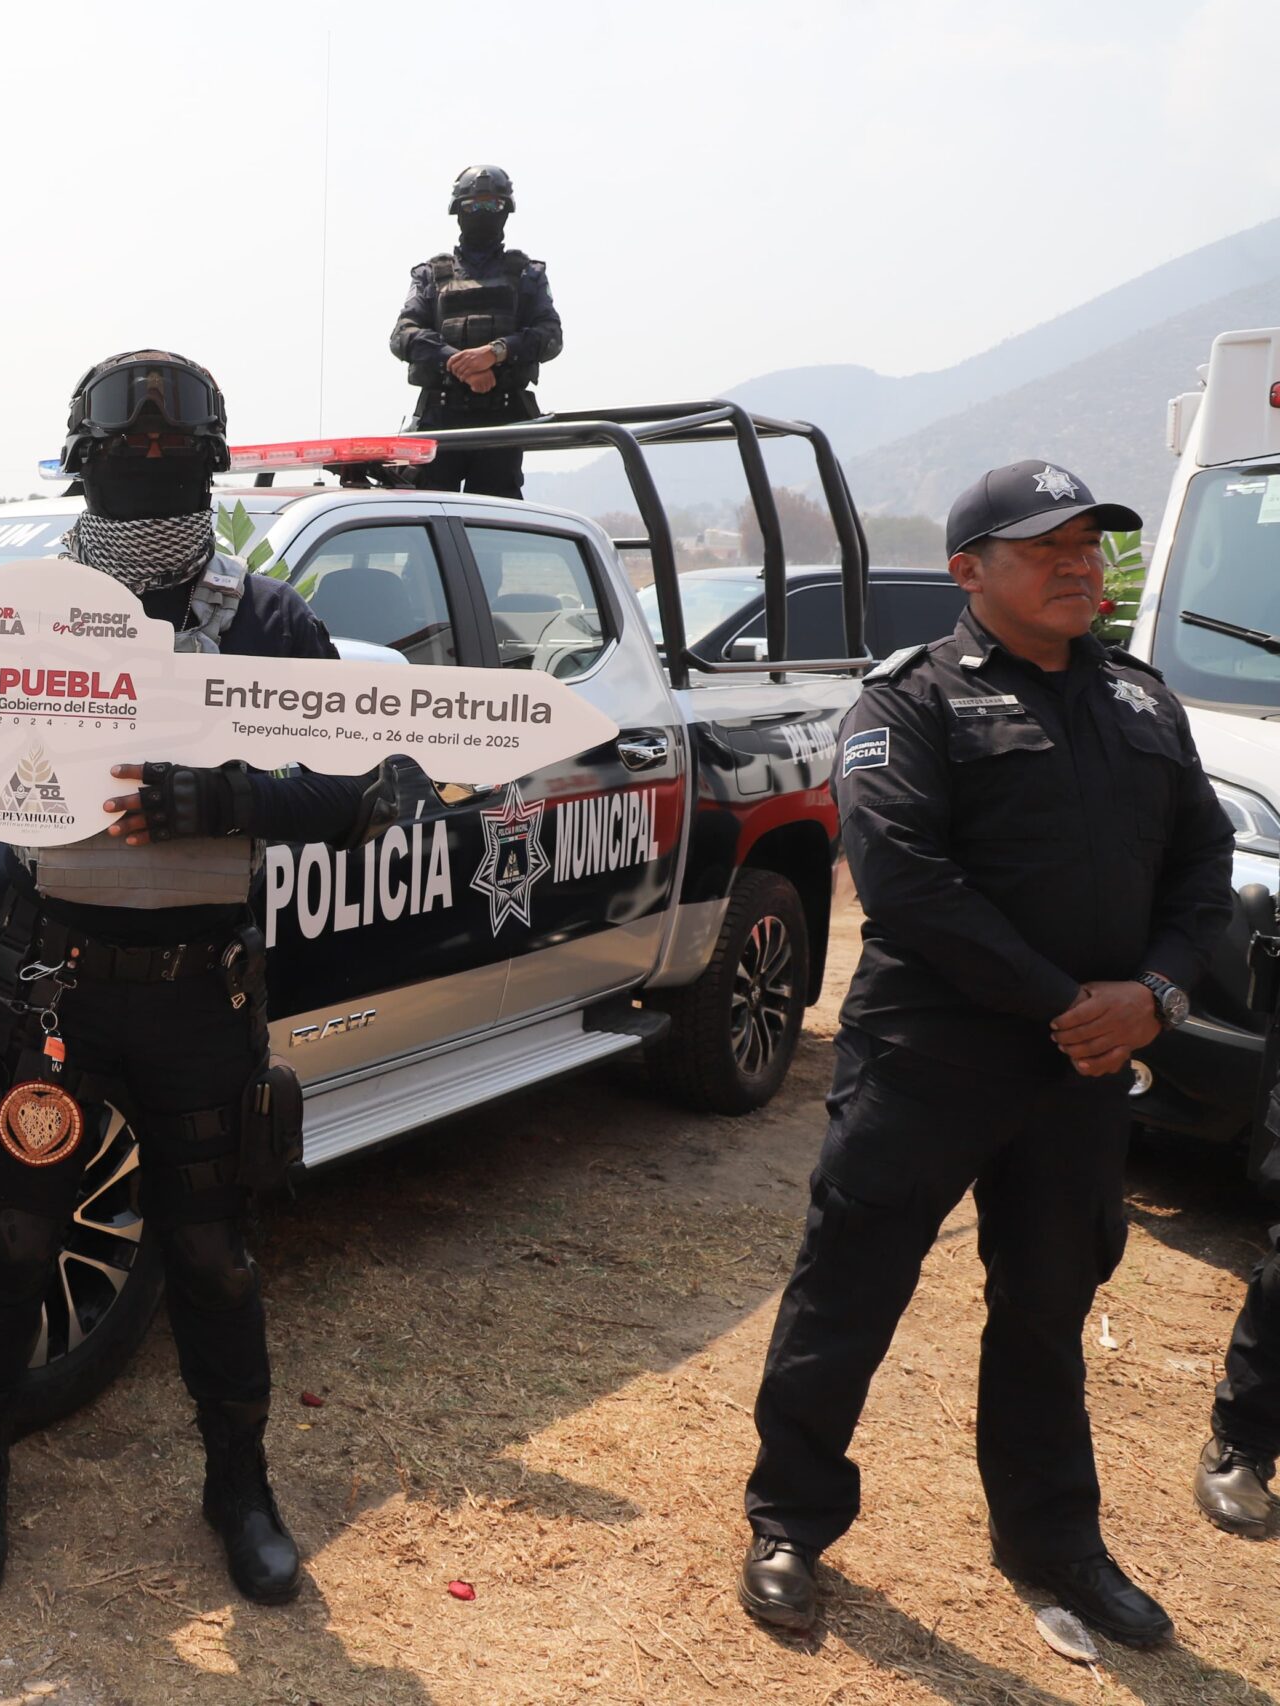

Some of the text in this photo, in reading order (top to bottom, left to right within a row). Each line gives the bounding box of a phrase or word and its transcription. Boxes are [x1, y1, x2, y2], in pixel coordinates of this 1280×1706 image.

[69, 607, 130, 625] Pensar
[70, 621, 138, 639] Grande
[64, 700, 85, 713] del
[88, 702, 137, 716] Estado
[204, 678, 552, 724] Entrega de Patrulla
[232, 721, 520, 748] Tepeyahualco, Pue., a 26 de abril de 2025
[845, 747, 885, 765] SOCIAL
[265, 787, 659, 949] POLICÍA MUNICIPAL
